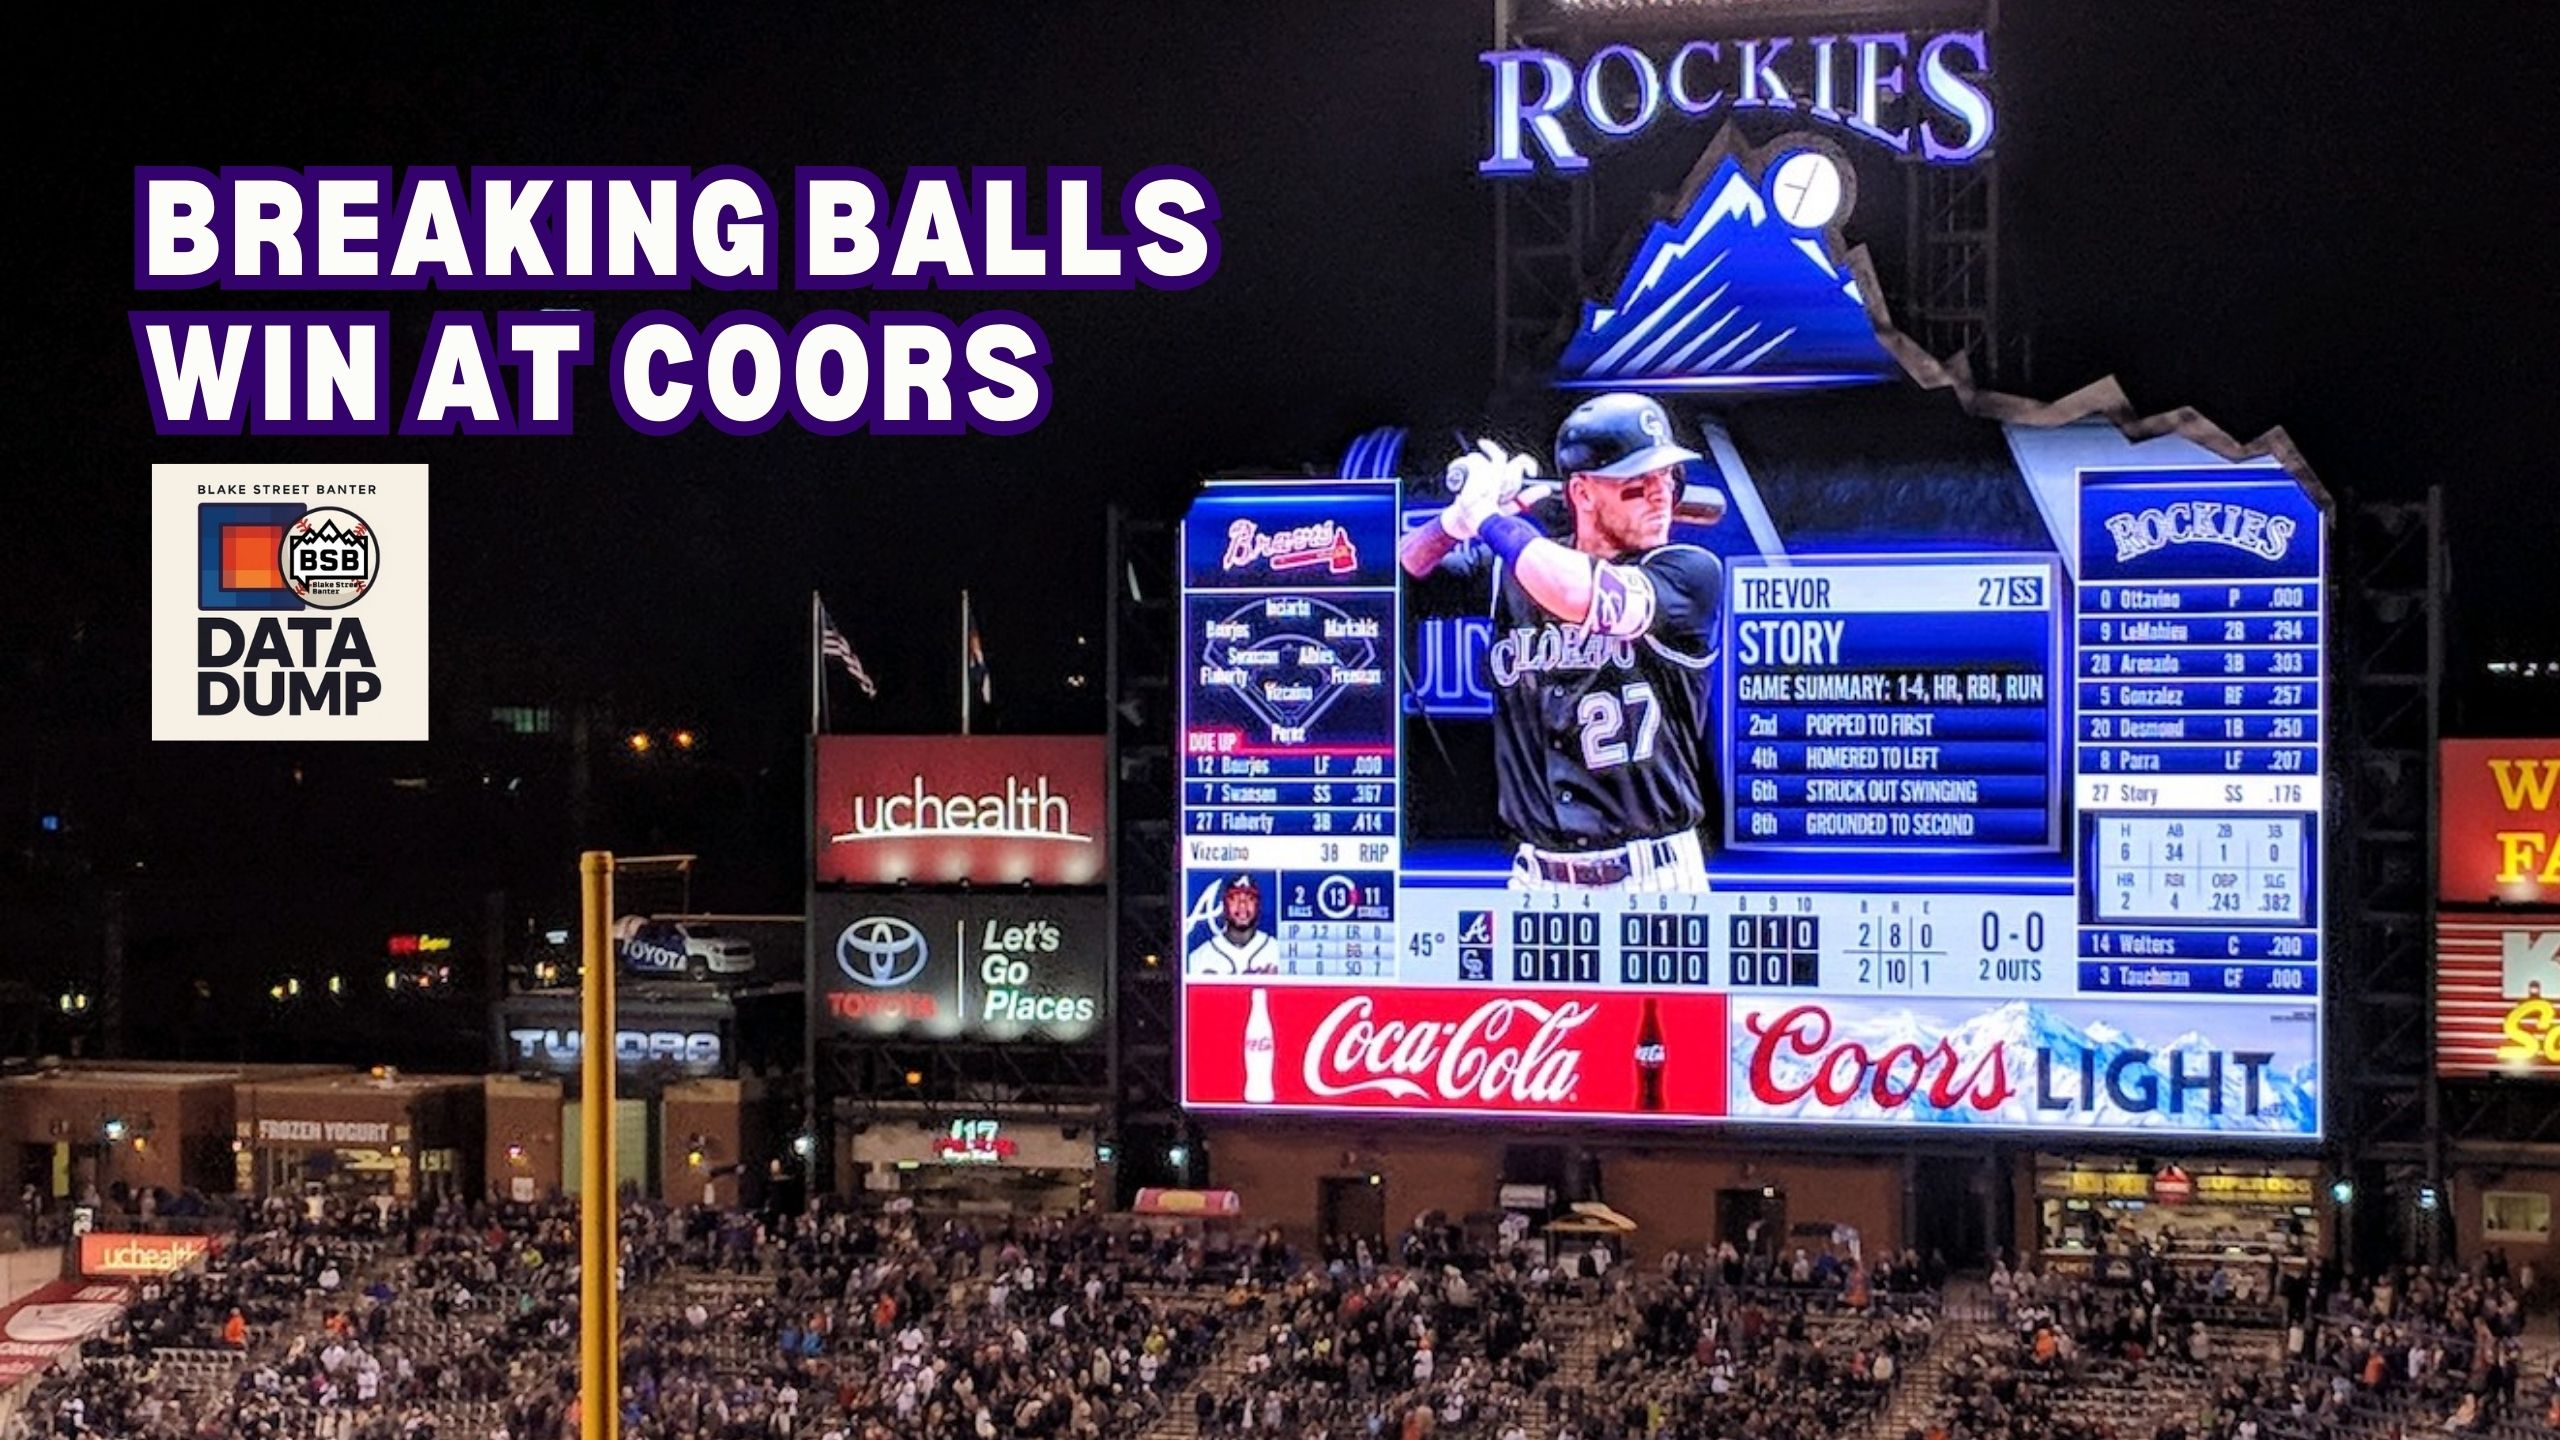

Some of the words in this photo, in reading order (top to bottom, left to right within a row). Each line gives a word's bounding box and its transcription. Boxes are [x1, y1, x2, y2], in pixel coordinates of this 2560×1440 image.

[1479, 30, 1995, 176] ROCKIES
[2105, 501, 2296, 562] ROCKIES
[1223, 519, 1335, 571] Braves
[1742, 577, 1830, 608] TREVOR
[1979, 577, 2006, 606] 27
[2012, 577, 2039, 605] SS
[2121, 588, 2180, 608] Ottavino
[2228, 588, 2241, 607] P
[2269, 587, 2303, 607] .000
[1738, 619, 1845, 665] STORY
[2121, 621, 2188, 641] LeMahieu
[2269, 620, 2303, 641] .294
[2121, 653, 2179, 674] Arenado
[2224, 653, 2244, 673] 3B
[2268, 652, 2303, 673] .303
[1739, 674, 1792, 700] GAME
[1794, 674, 1891, 701] SUMMARY:
[1898, 674, 1929, 703] 1-4,
[1933, 674, 1963, 703] HR,
[1967, 674, 2002, 703] RBI,
[2005, 674, 2044, 700] RUN
[2101, 686, 2110, 706] 5
[2120, 686, 2184, 706] Gonzalez
[2224, 686, 2244, 705] RF
[2268, 686, 2302, 706] .257
[1271, 725, 1306, 743] Perez
[1577, 681, 1661, 770] 27
[1750, 713, 1777, 736] 2nd
[1806, 713, 1866, 736] POPPED
[1868, 713, 1888, 736] TO
[1891, 713, 1935, 736] FIRST
[2091, 718, 2111, 738] 20
[2120, 718, 2184, 738] Desmond
[2225, 718, 2244, 738] 1B
[2268, 718, 2302, 738] .250
[1189, 733, 1216, 751] DUE
[1218, 733, 1237, 751] UP
[1197, 756, 1214, 775] 12
[1314, 756, 1331, 775] LF
[1751, 747, 1778, 769] 4th
[1806, 747, 1878, 769] HOMERED
[1881, 747, 1901, 769] TO
[1904, 747, 1940, 769] LEFT
[2100, 751, 2110, 770] 8
[2120, 751, 2160, 770] Parra
[2225, 750, 2244, 770] LF
[2267, 751, 2302, 770] .207
[1313, 783, 1331, 803] SS
[1751, 780, 1778, 802] 6th
[1806, 780, 1865, 802] STRUCK
[1868, 780, 1899, 802] OUT
[1901, 781, 1978, 803] SWINGING
[2092, 785, 2109, 802] 27
[2121, 784, 2158, 805] Story
[2225, 785, 2243, 802] SS
[2268, 785, 2302, 803] .176
[854, 775, 1070, 835] uchealth
[1196, 812, 1213, 831] 27
[1221, 812, 1274, 834] Flaherty
[1352, 812, 1382, 832] .414
[1751, 813, 1778, 835] 8th
[1806, 813, 1886, 835] GROUNDED
[1889, 813, 1910, 835] TO
[1913, 814, 1975, 836] SECOND
[2121, 823, 2131, 837] H
[2166, 823, 2184, 837] AB
[2217, 823, 2232, 838] 2B
[1191, 841, 1249, 862] Vizcaino
[1321, 843, 1338, 862] 38
[1360, 842, 1389, 862] RHP
[2121, 843, 2130, 861] 6
[2165, 843, 2183, 861] 34
[2270, 844, 2279, 862] 0
[2116, 873, 2135, 887] HR
[2212, 873, 2238, 888] OBP
[2264, 874, 2285, 888] SLG
[1294, 885, 1305, 905] 2
[1330, 886, 1346, 907] 13
[1364, 886, 1380, 906] 11
[2121, 892, 2130, 910] 2
[2170, 892, 2179, 910] 4
[2207, 893, 2240, 911] .243
[2257, 893, 2291, 912] .382
[982, 920, 1061, 951] Let's
[1409, 932, 1446, 956] 45°
[1859, 923, 1870, 947] 2
[1890, 923, 1901, 948] 8
[1921, 924, 1932, 948] 0
[2091, 934, 2110, 953] 14
[2119, 934, 2175, 955] Wolters
[2228, 936, 2240, 956] C
[2267, 936, 2302, 956] .200
[622, 941, 687, 970] TOYOTA
[981, 953, 1030, 985] Go
[1859, 959, 1870, 983] 2
[1886, 959, 1906, 984] 10
[1980, 959, 1990, 981] 2
[1996, 959, 2042, 982] OUTS
[2101, 966, 2110, 985] 3
[2119, 966, 2190, 987] Tauchman
[2267, 968, 2302, 989] .000
[828, 991, 937, 1019] TOYOTA
[983, 990, 1094, 1022] Places
[509, 1029, 721, 1063] TUDRA
[1303, 995, 1598, 1102] Coca-Cola
[1746, 1004, 2016, 1113] Coors
[2036, 1047, 2275, 1116] LIGHT
[258, 1119, 322, 1140] FROZEN
[324, 1120, 390, 1142] YOGURT
